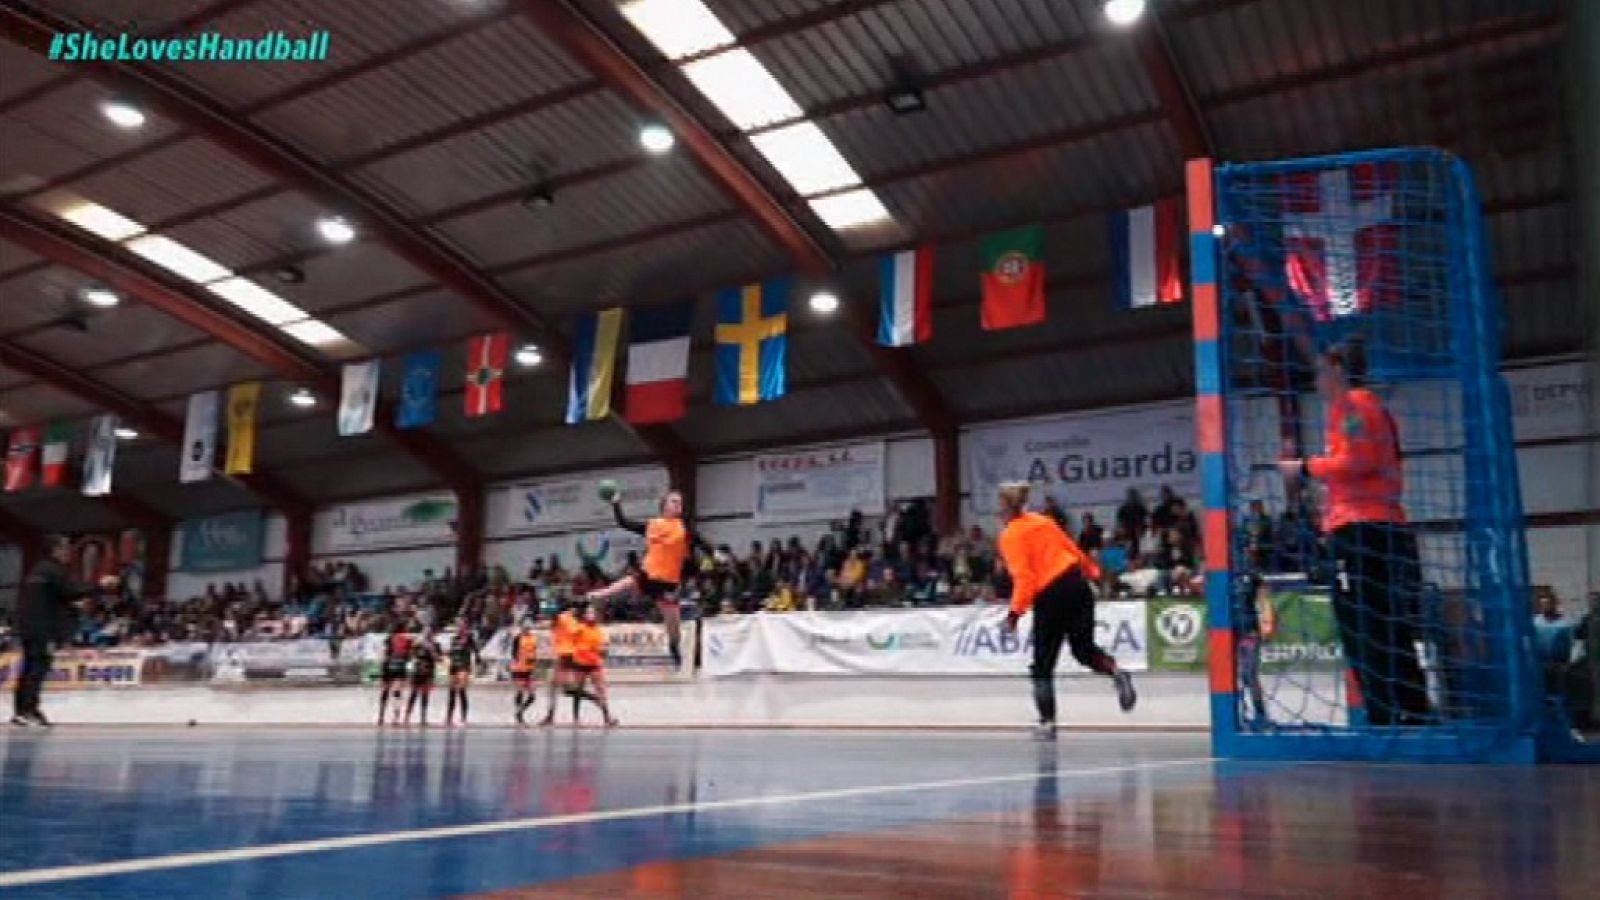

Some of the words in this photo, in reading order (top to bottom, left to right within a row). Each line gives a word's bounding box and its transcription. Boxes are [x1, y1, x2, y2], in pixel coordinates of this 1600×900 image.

[1028, 457, 1048, 482] A
[1058, 443, 1197, 482] Guarda
[973, 620, 1141, 655] ABA
